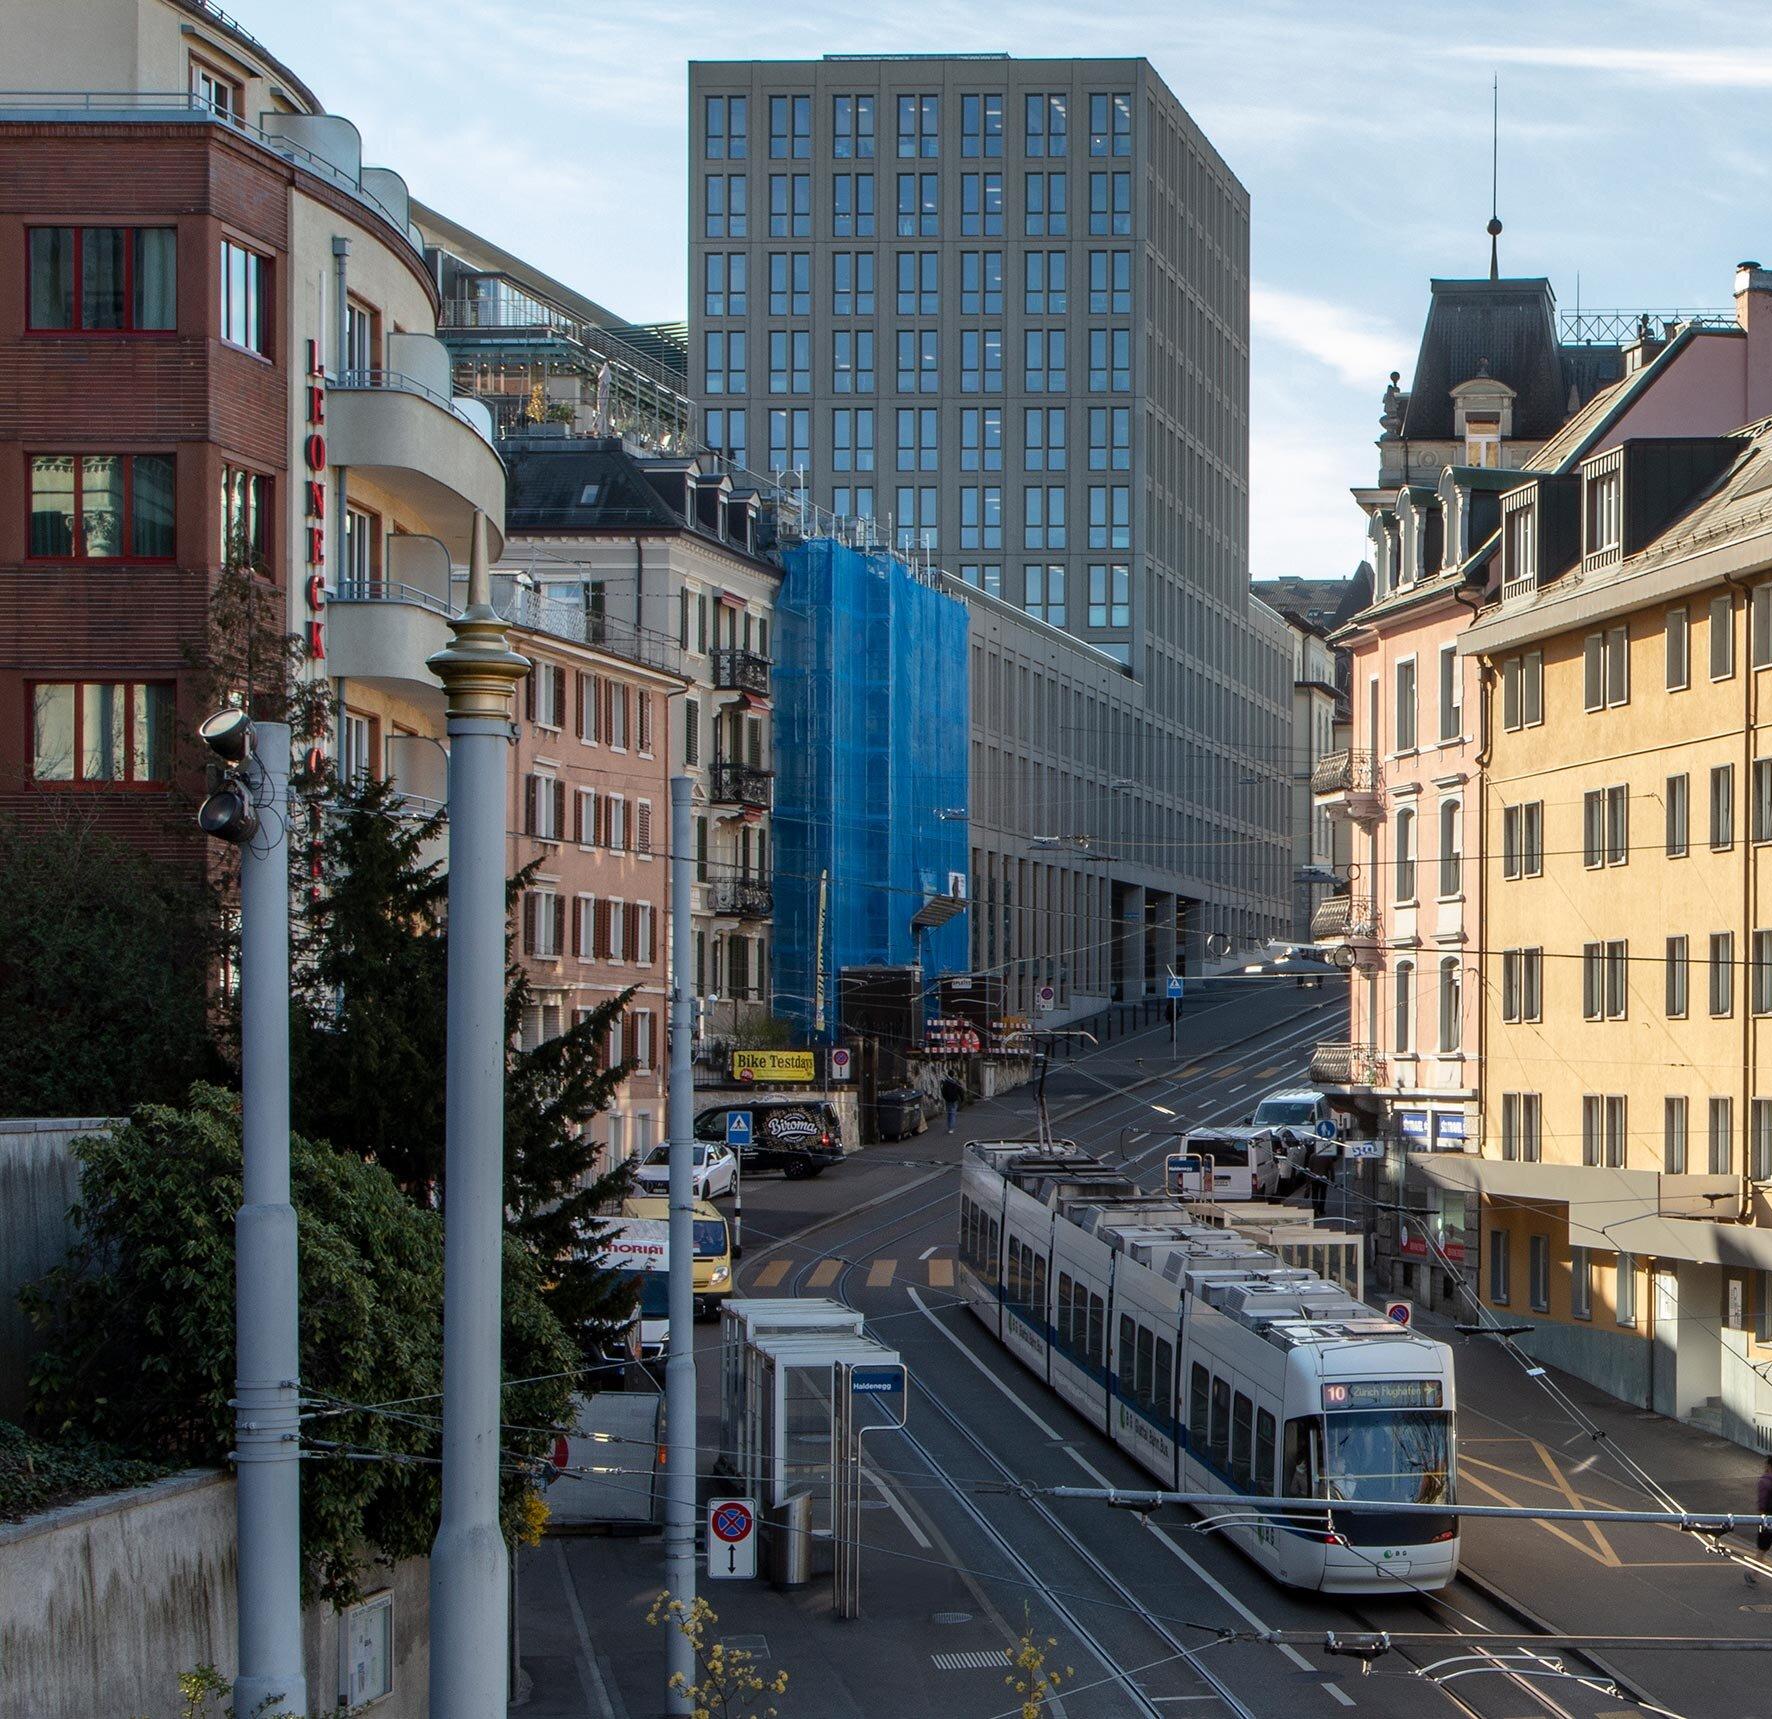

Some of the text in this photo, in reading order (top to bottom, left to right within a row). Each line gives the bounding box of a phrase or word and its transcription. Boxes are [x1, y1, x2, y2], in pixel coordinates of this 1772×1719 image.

[306, 338, 325, 660] LEONECK
[737, 1054, 766, 1068] Bike
[853, 1382, 892, 1391] Haldenegg
[1327, 1386, 1346, 1401] 10
